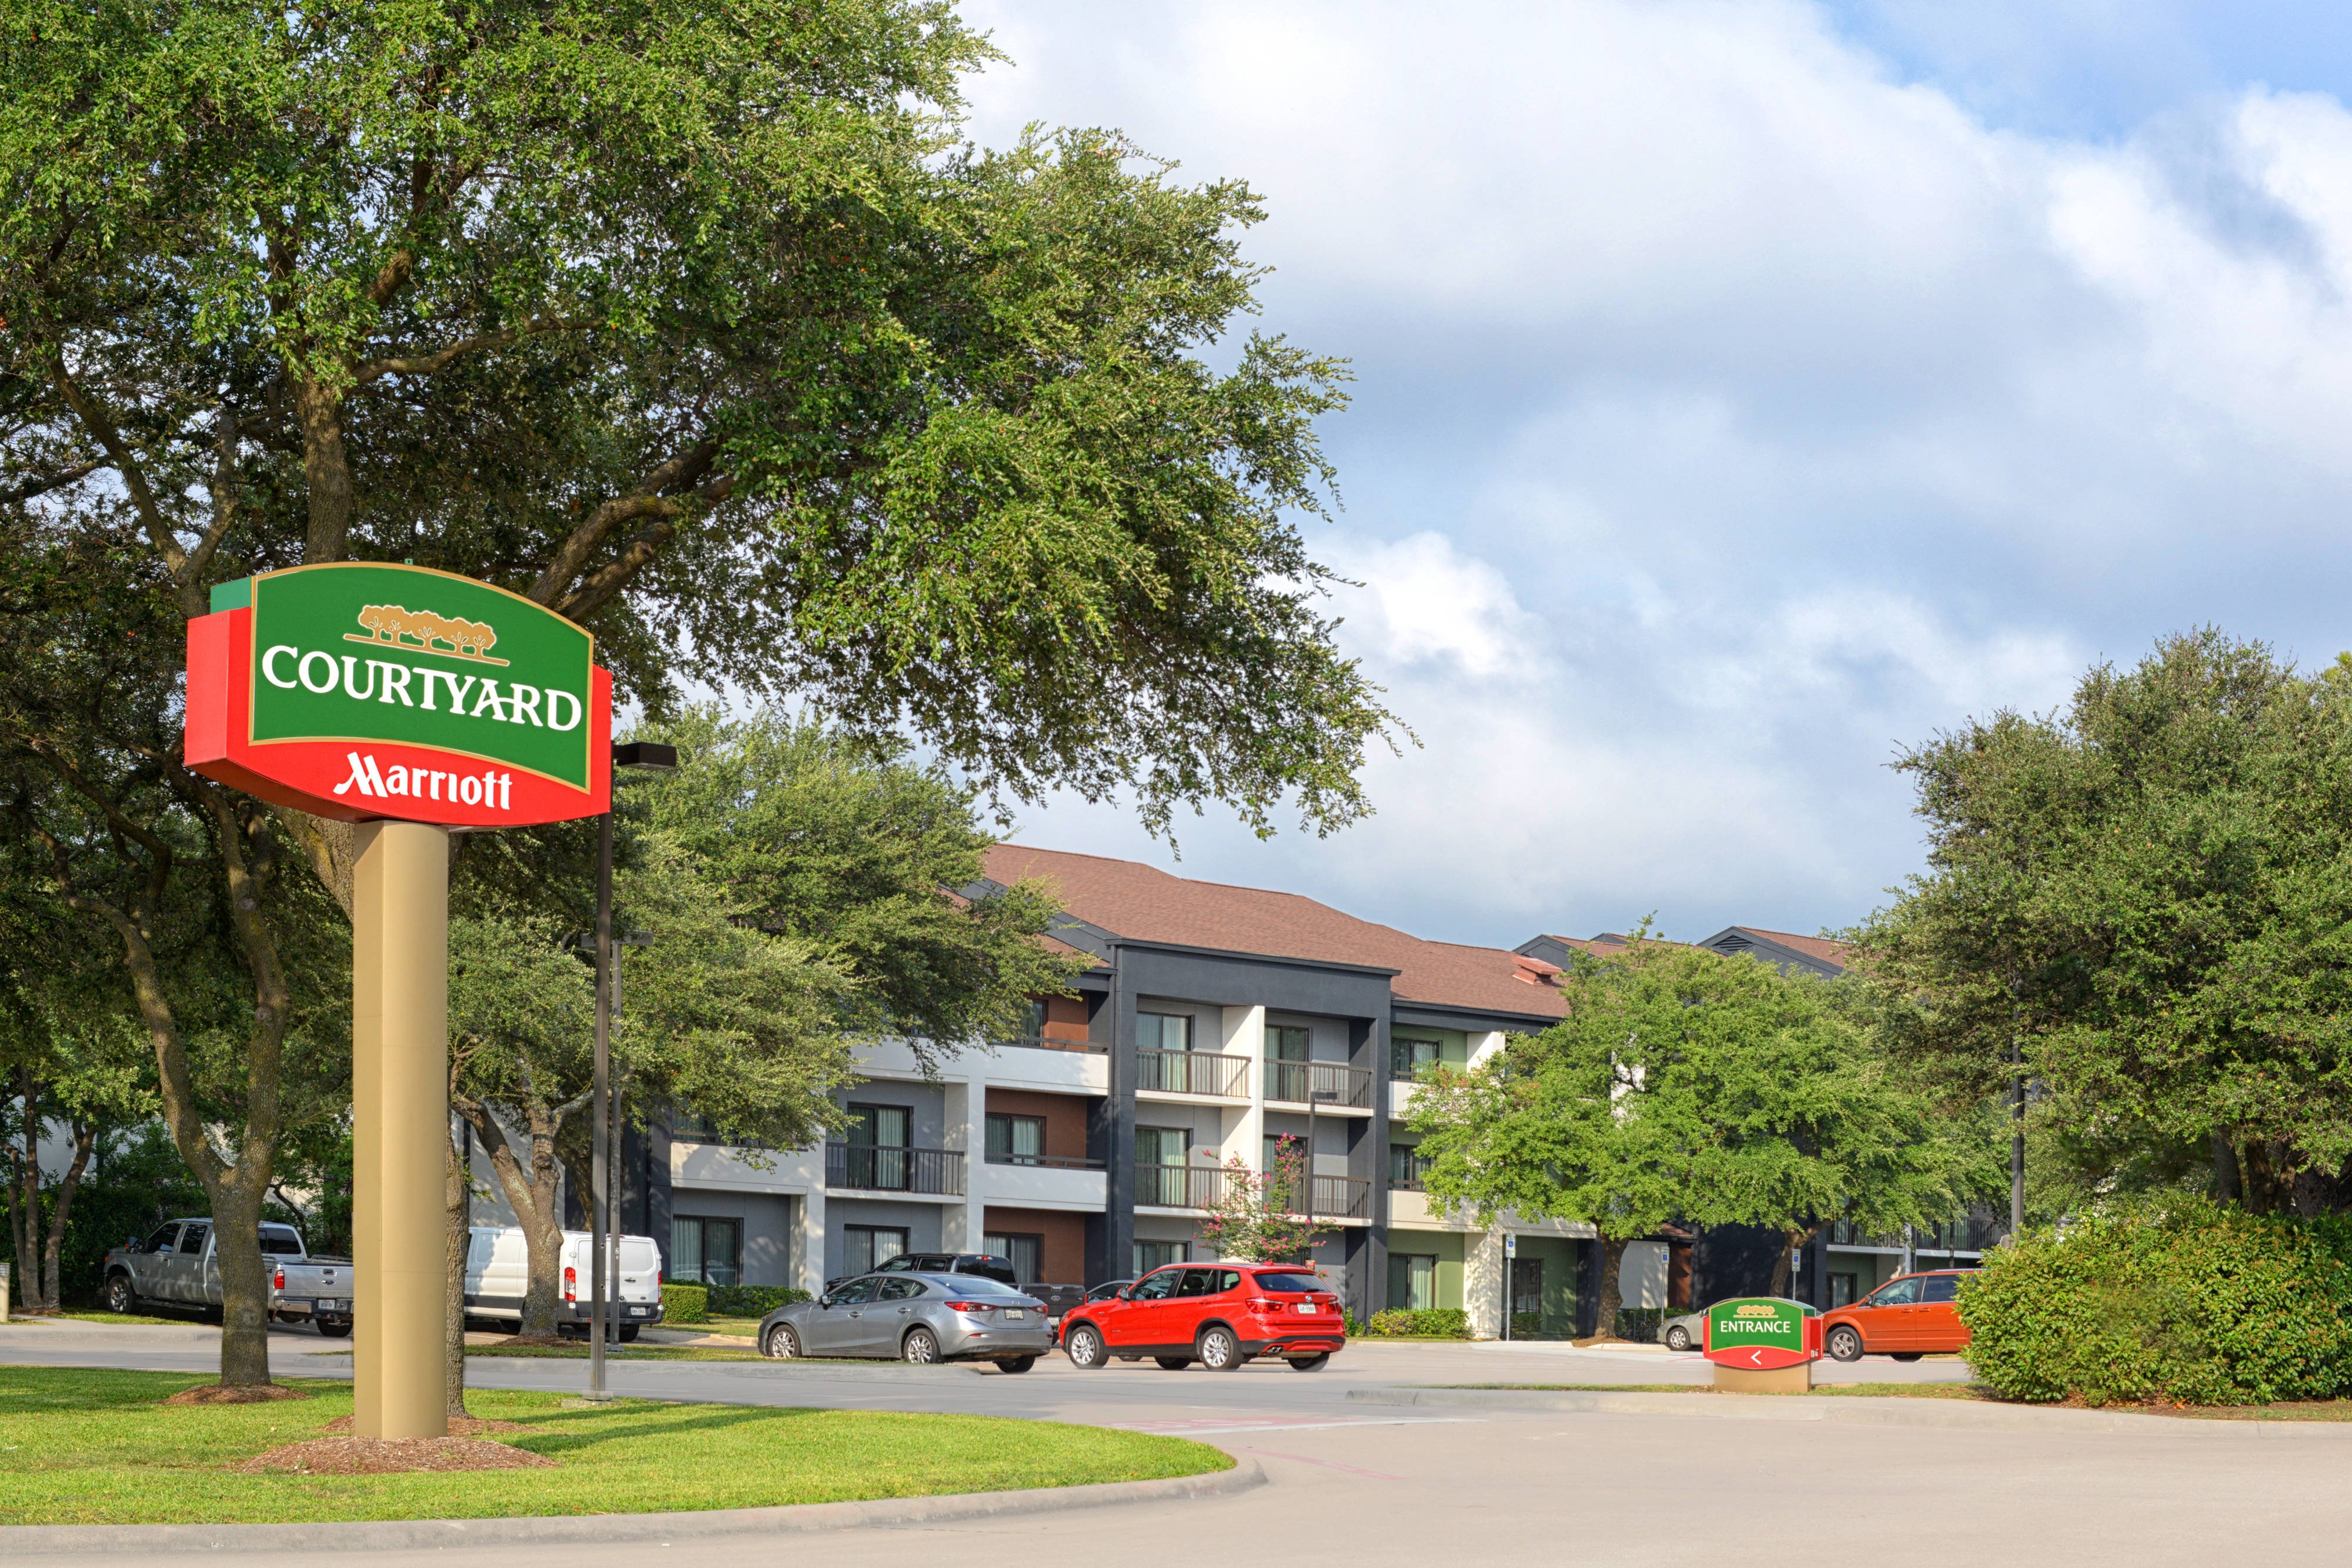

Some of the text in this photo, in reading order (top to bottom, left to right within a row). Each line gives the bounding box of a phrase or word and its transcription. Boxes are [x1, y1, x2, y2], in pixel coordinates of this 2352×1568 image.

[262, 645, 582, 731] COURTYARD
[333, 751, 513, 810] Marriott
[1720, 1320, 1791, 1333] ENTRANCE
